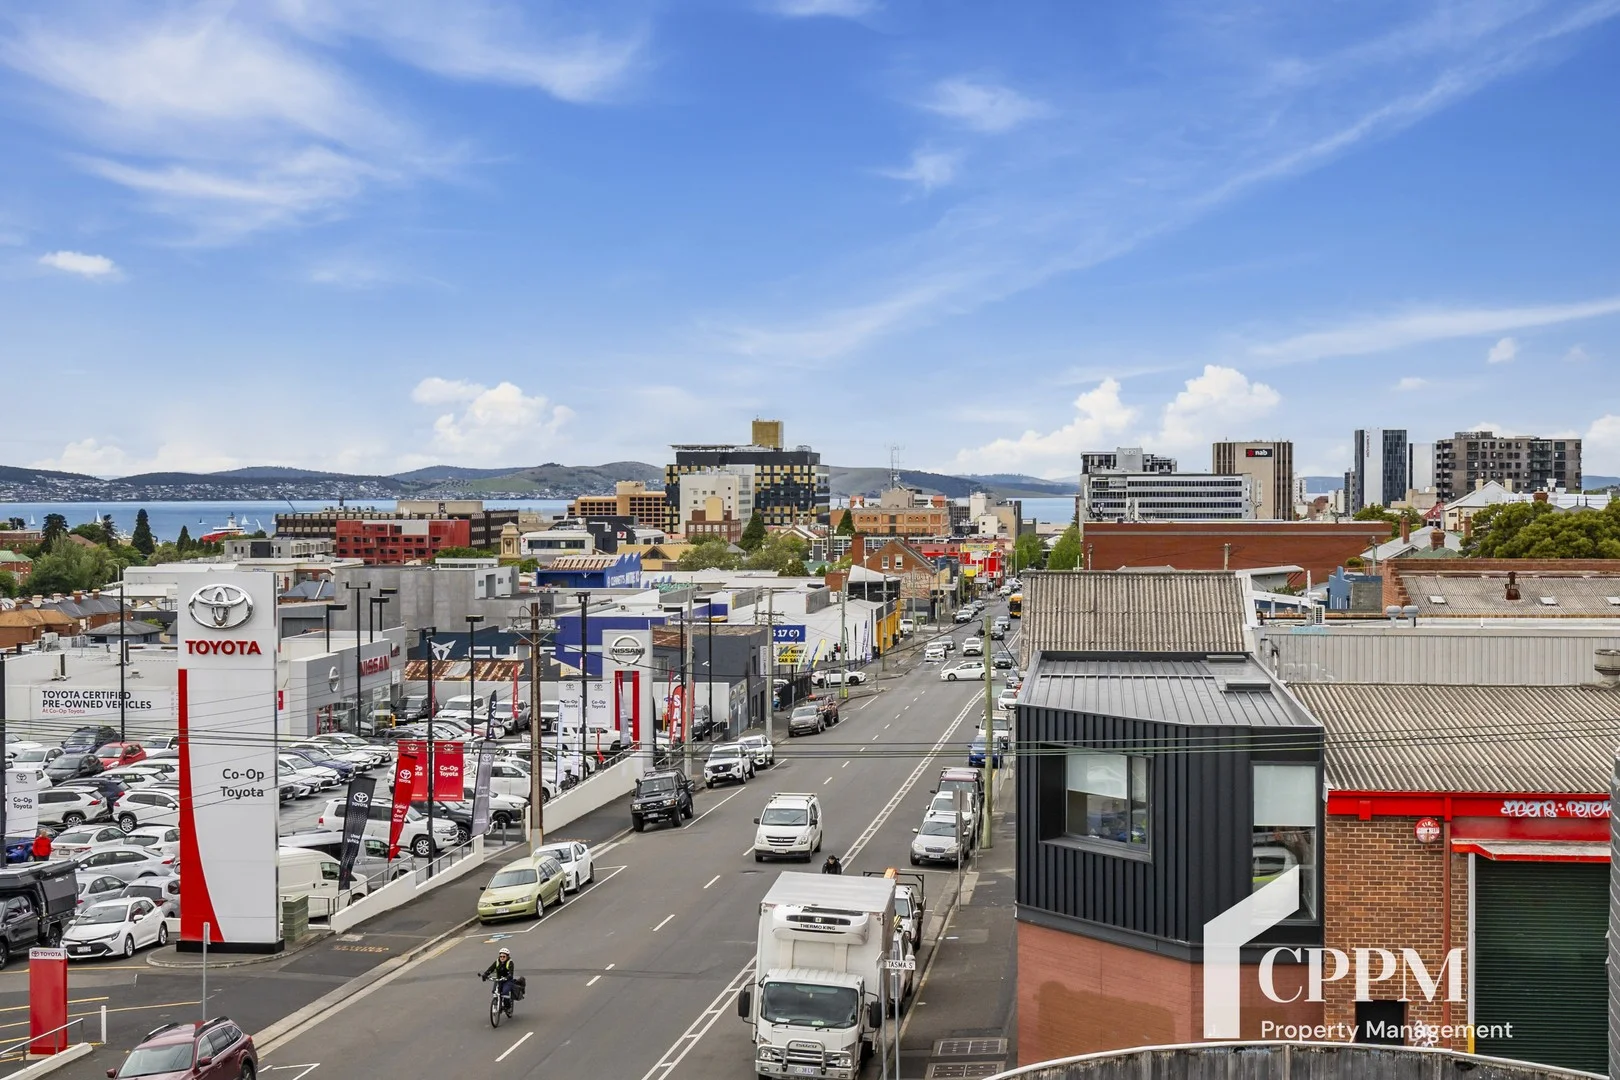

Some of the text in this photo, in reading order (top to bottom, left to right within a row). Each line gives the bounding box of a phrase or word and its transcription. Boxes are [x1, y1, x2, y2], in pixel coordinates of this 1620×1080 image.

[777, 629, 787, 637] 17
[185, 640, 262, 655] TOYOTA
[360, 655, 390, 677] NISSAN
[42, 691, 131, 700] TOYOTA CERTIFIED
[42, 700, 152, 709] PRE-OWNED VEHICLES
[222, 768, 264, 782] Co-Op
[220, 786, 264, 800] Toyota
